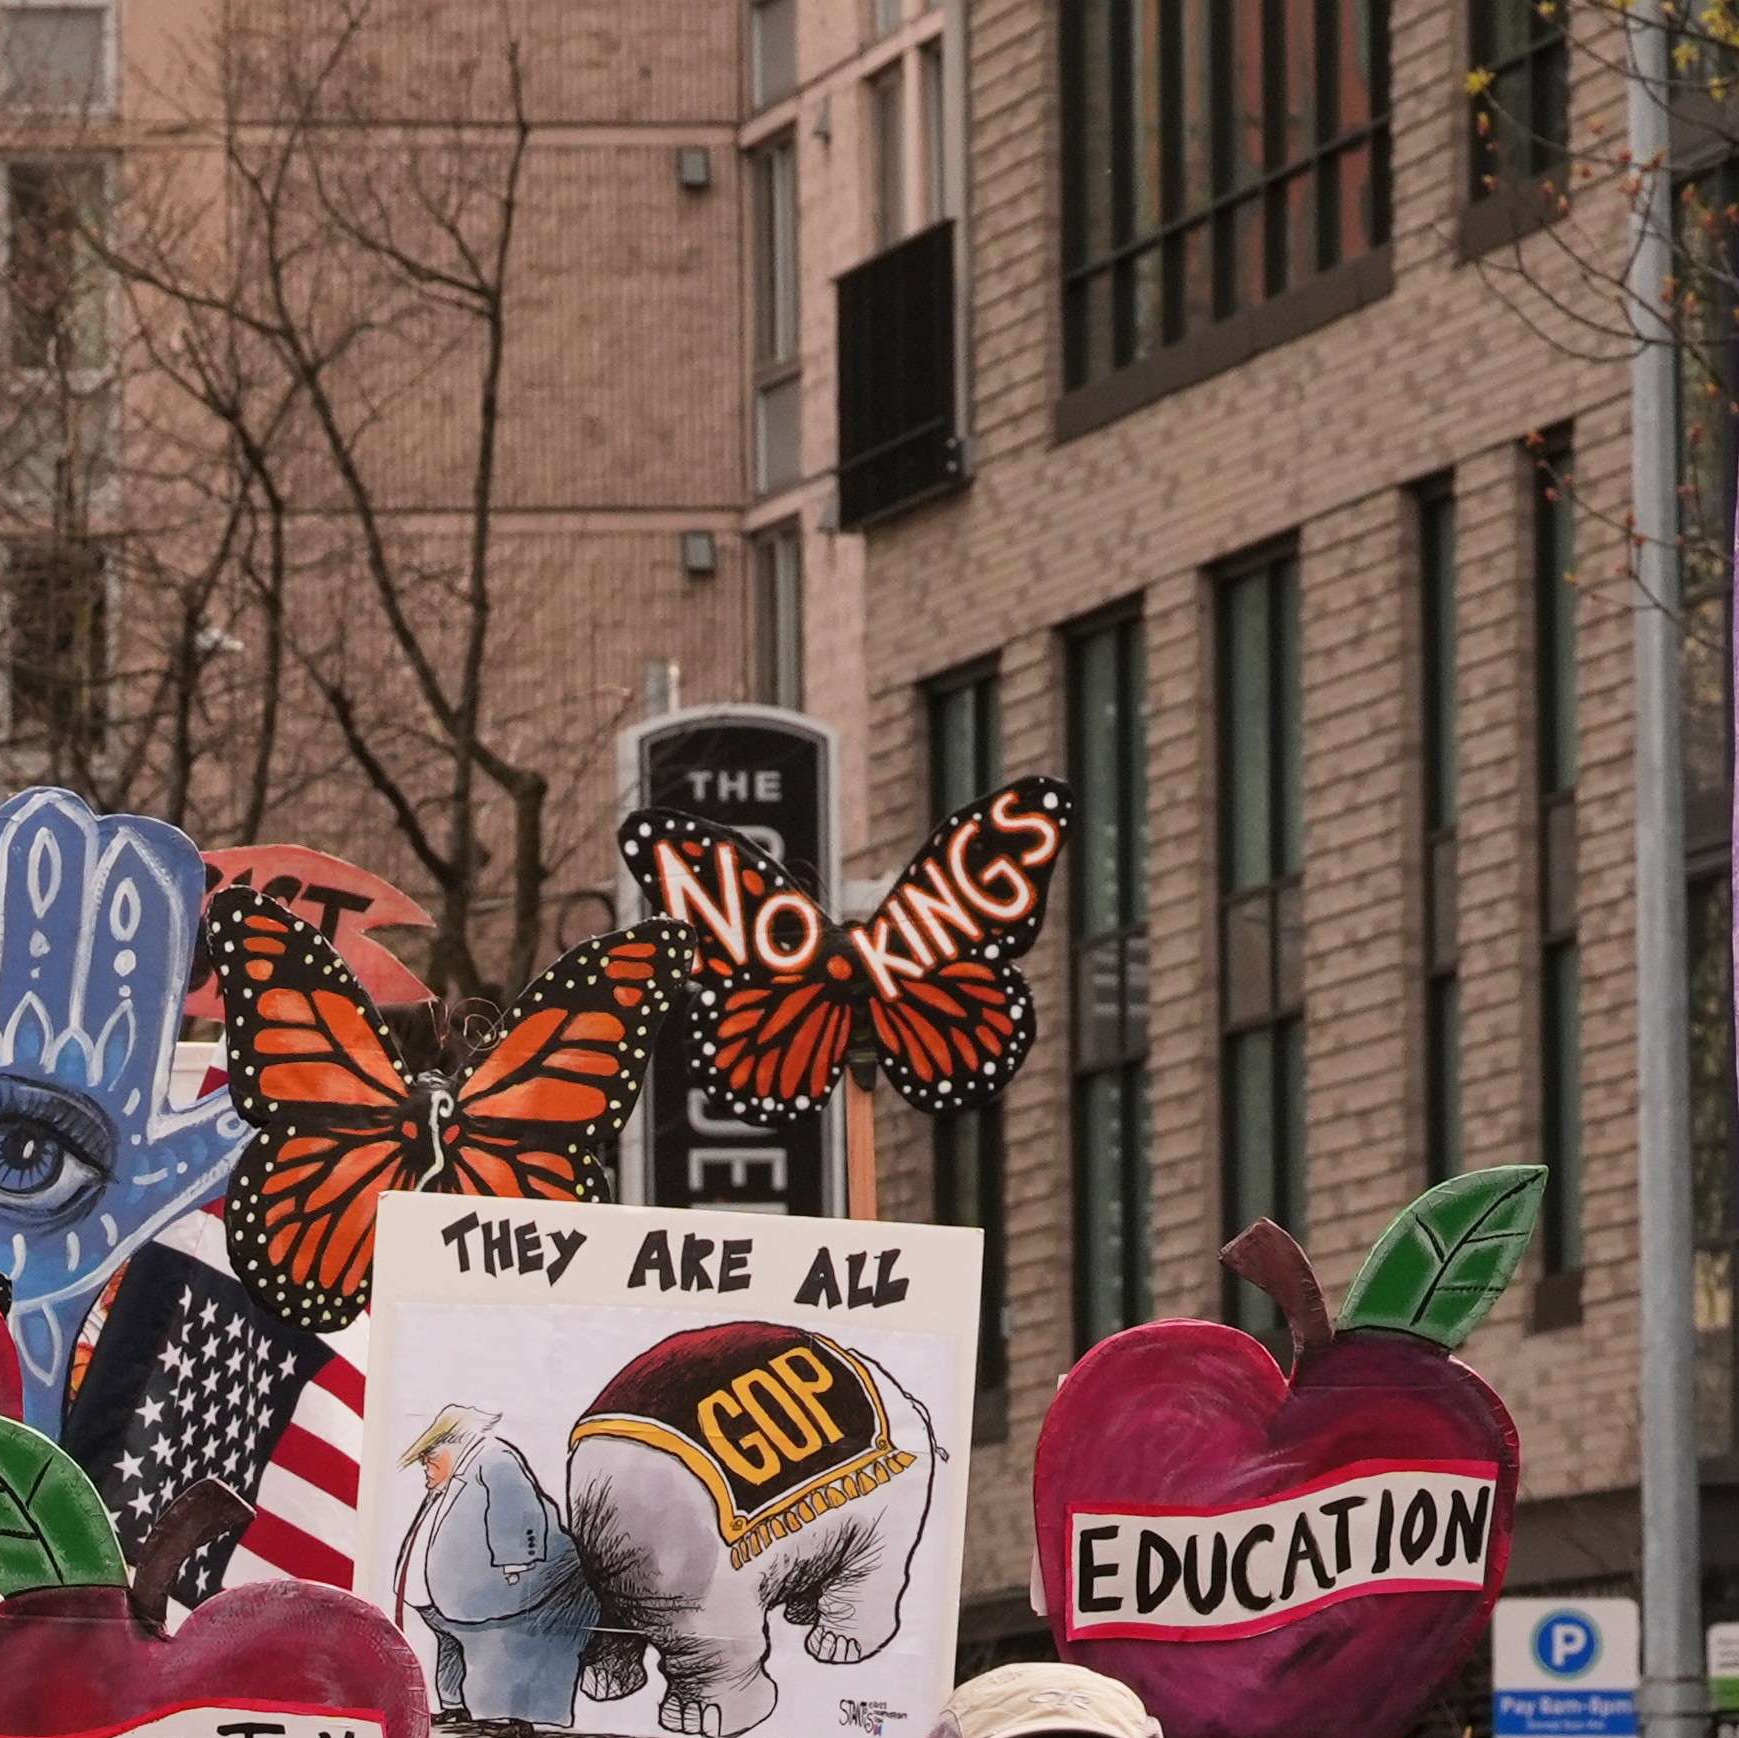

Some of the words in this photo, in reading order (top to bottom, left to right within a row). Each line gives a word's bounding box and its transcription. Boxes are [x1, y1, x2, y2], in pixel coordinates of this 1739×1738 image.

[687, 770, 783, 802] THE
[654, 838, 820, 976] NO
[849, 788, 1061, 1003] KINGS
[441, 1211, 589, 1288] THEY
[626, 1228, 755, 1293] ARE
[793, 1246, 911, 1310] ALL
[695, 1344, 849, 1487] GOP
[1077, 1485, 1491, 1615] EDUCATION
